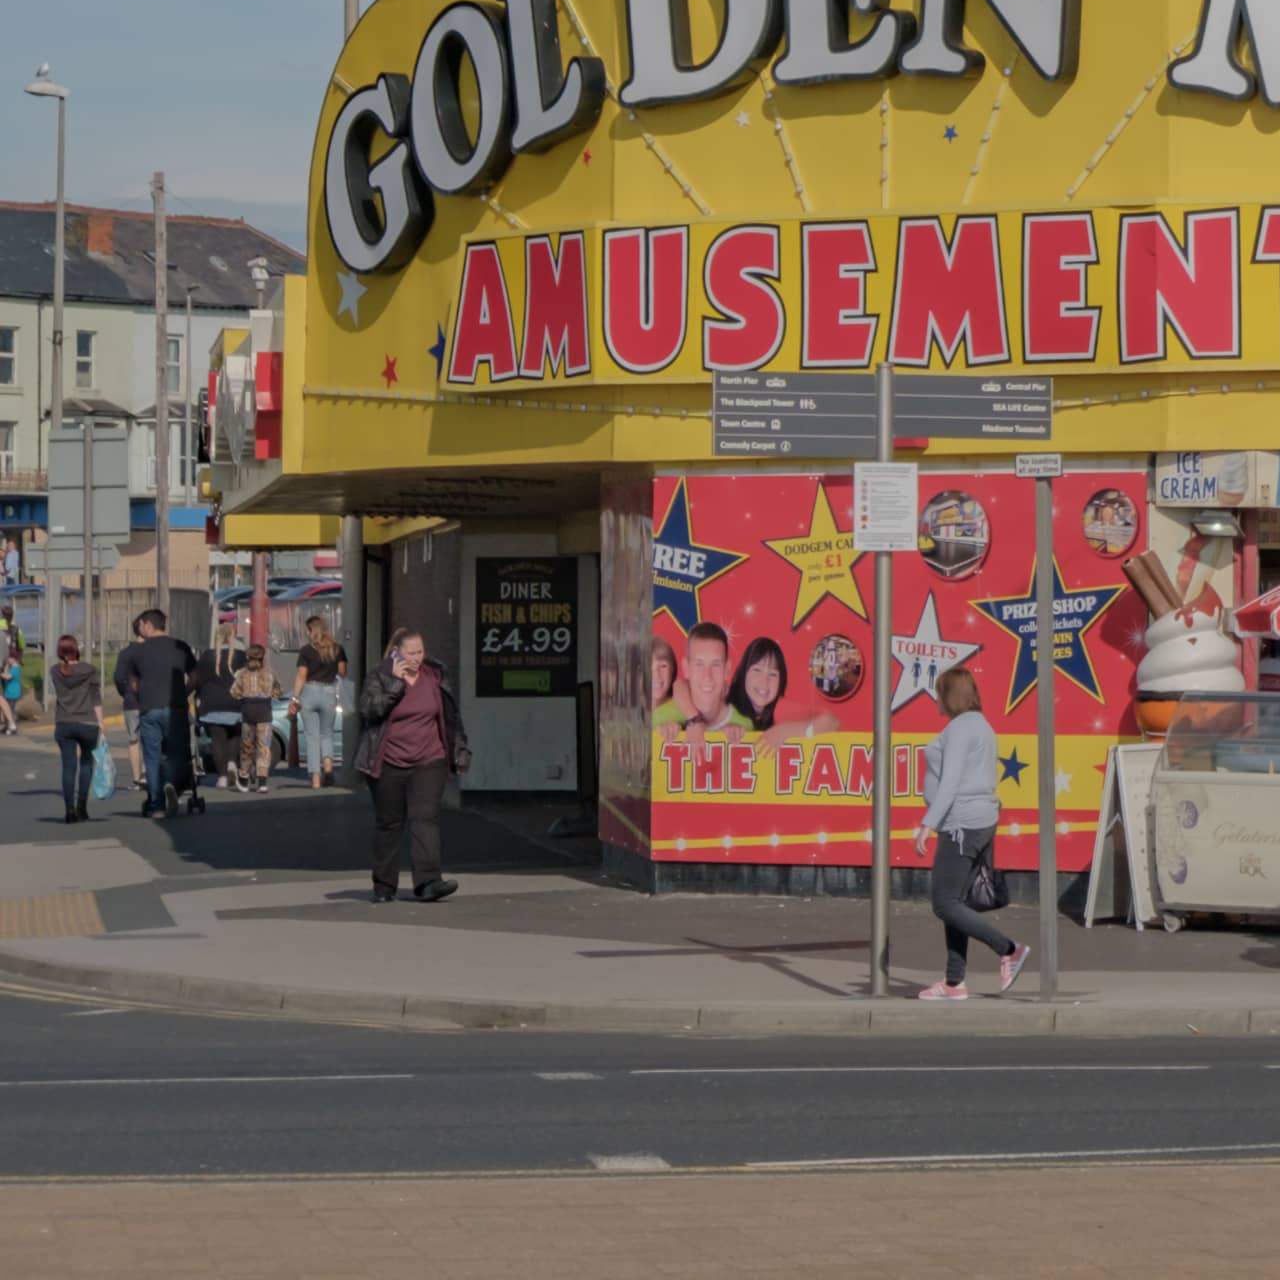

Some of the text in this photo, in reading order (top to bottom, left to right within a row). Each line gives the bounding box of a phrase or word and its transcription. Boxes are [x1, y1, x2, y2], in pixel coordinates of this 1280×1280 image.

[720, 376, 758, 385] North Pier
[1005, 382, 1046, 391] Central Pier
[720, 398, 795, 408] The Blackpool Tower
[992, 403, 1046, 412] SEA LIFE Centre
[720, 419, 766, 428] Town Centre
[720, 440, 776, 451] Comedy Carpet
[1031, 455, 1058, 466] loading
[1176, 451, 1201, 474] ICE
[1161, 477, 1216, 499] CREAM
[785, 540, 832, 556] DODGEM
[652, 543, 707, 578] REE
[825, 554, 842, 568] £1
[500, 582, 552, 599] DINER
[481, 603, 571, 624] FISH & CHIPS
[1002, 596, 1096, 620] PRIZ SHOP
[481, 627, 571, 652] £4.99
[896, 639, 958, 660] TOILETS
[661, 742, 756, 794] THE
